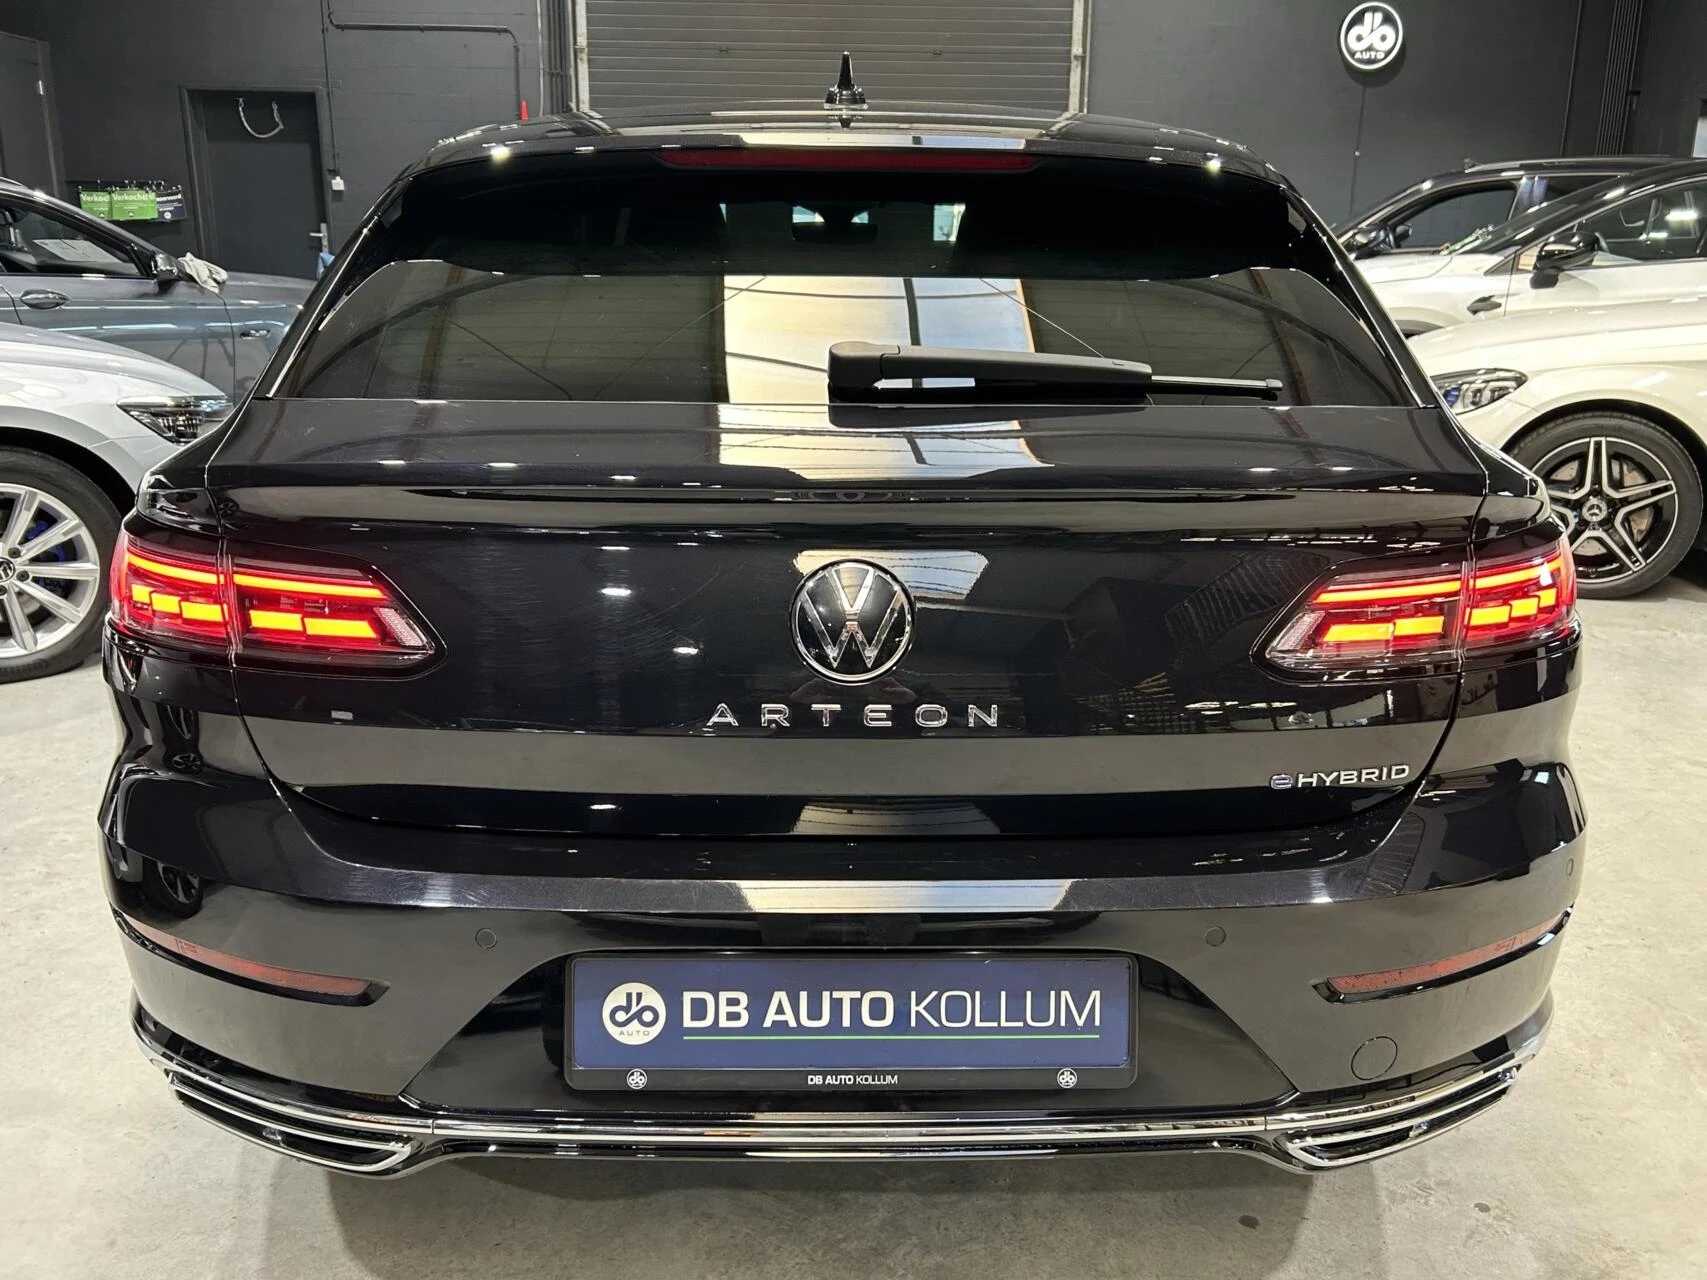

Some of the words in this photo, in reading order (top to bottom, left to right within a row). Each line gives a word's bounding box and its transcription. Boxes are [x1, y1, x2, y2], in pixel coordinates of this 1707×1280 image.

[1354, 50, 1385, 59] AUTO
[80, 193, 110, 202] Verkoc
[705, 703, 998, 727] ARTEON
[683, 990, 749, 1028] DB
[762, 990, 895, 1028] AUTO
[910, 990, 1101, 1028] KOLLUM
[807, 1074, 823, 1085] DB
[825, 1074, 854, 1085] AUTO
[855, 1074, 898, 1085] KOLLUM
